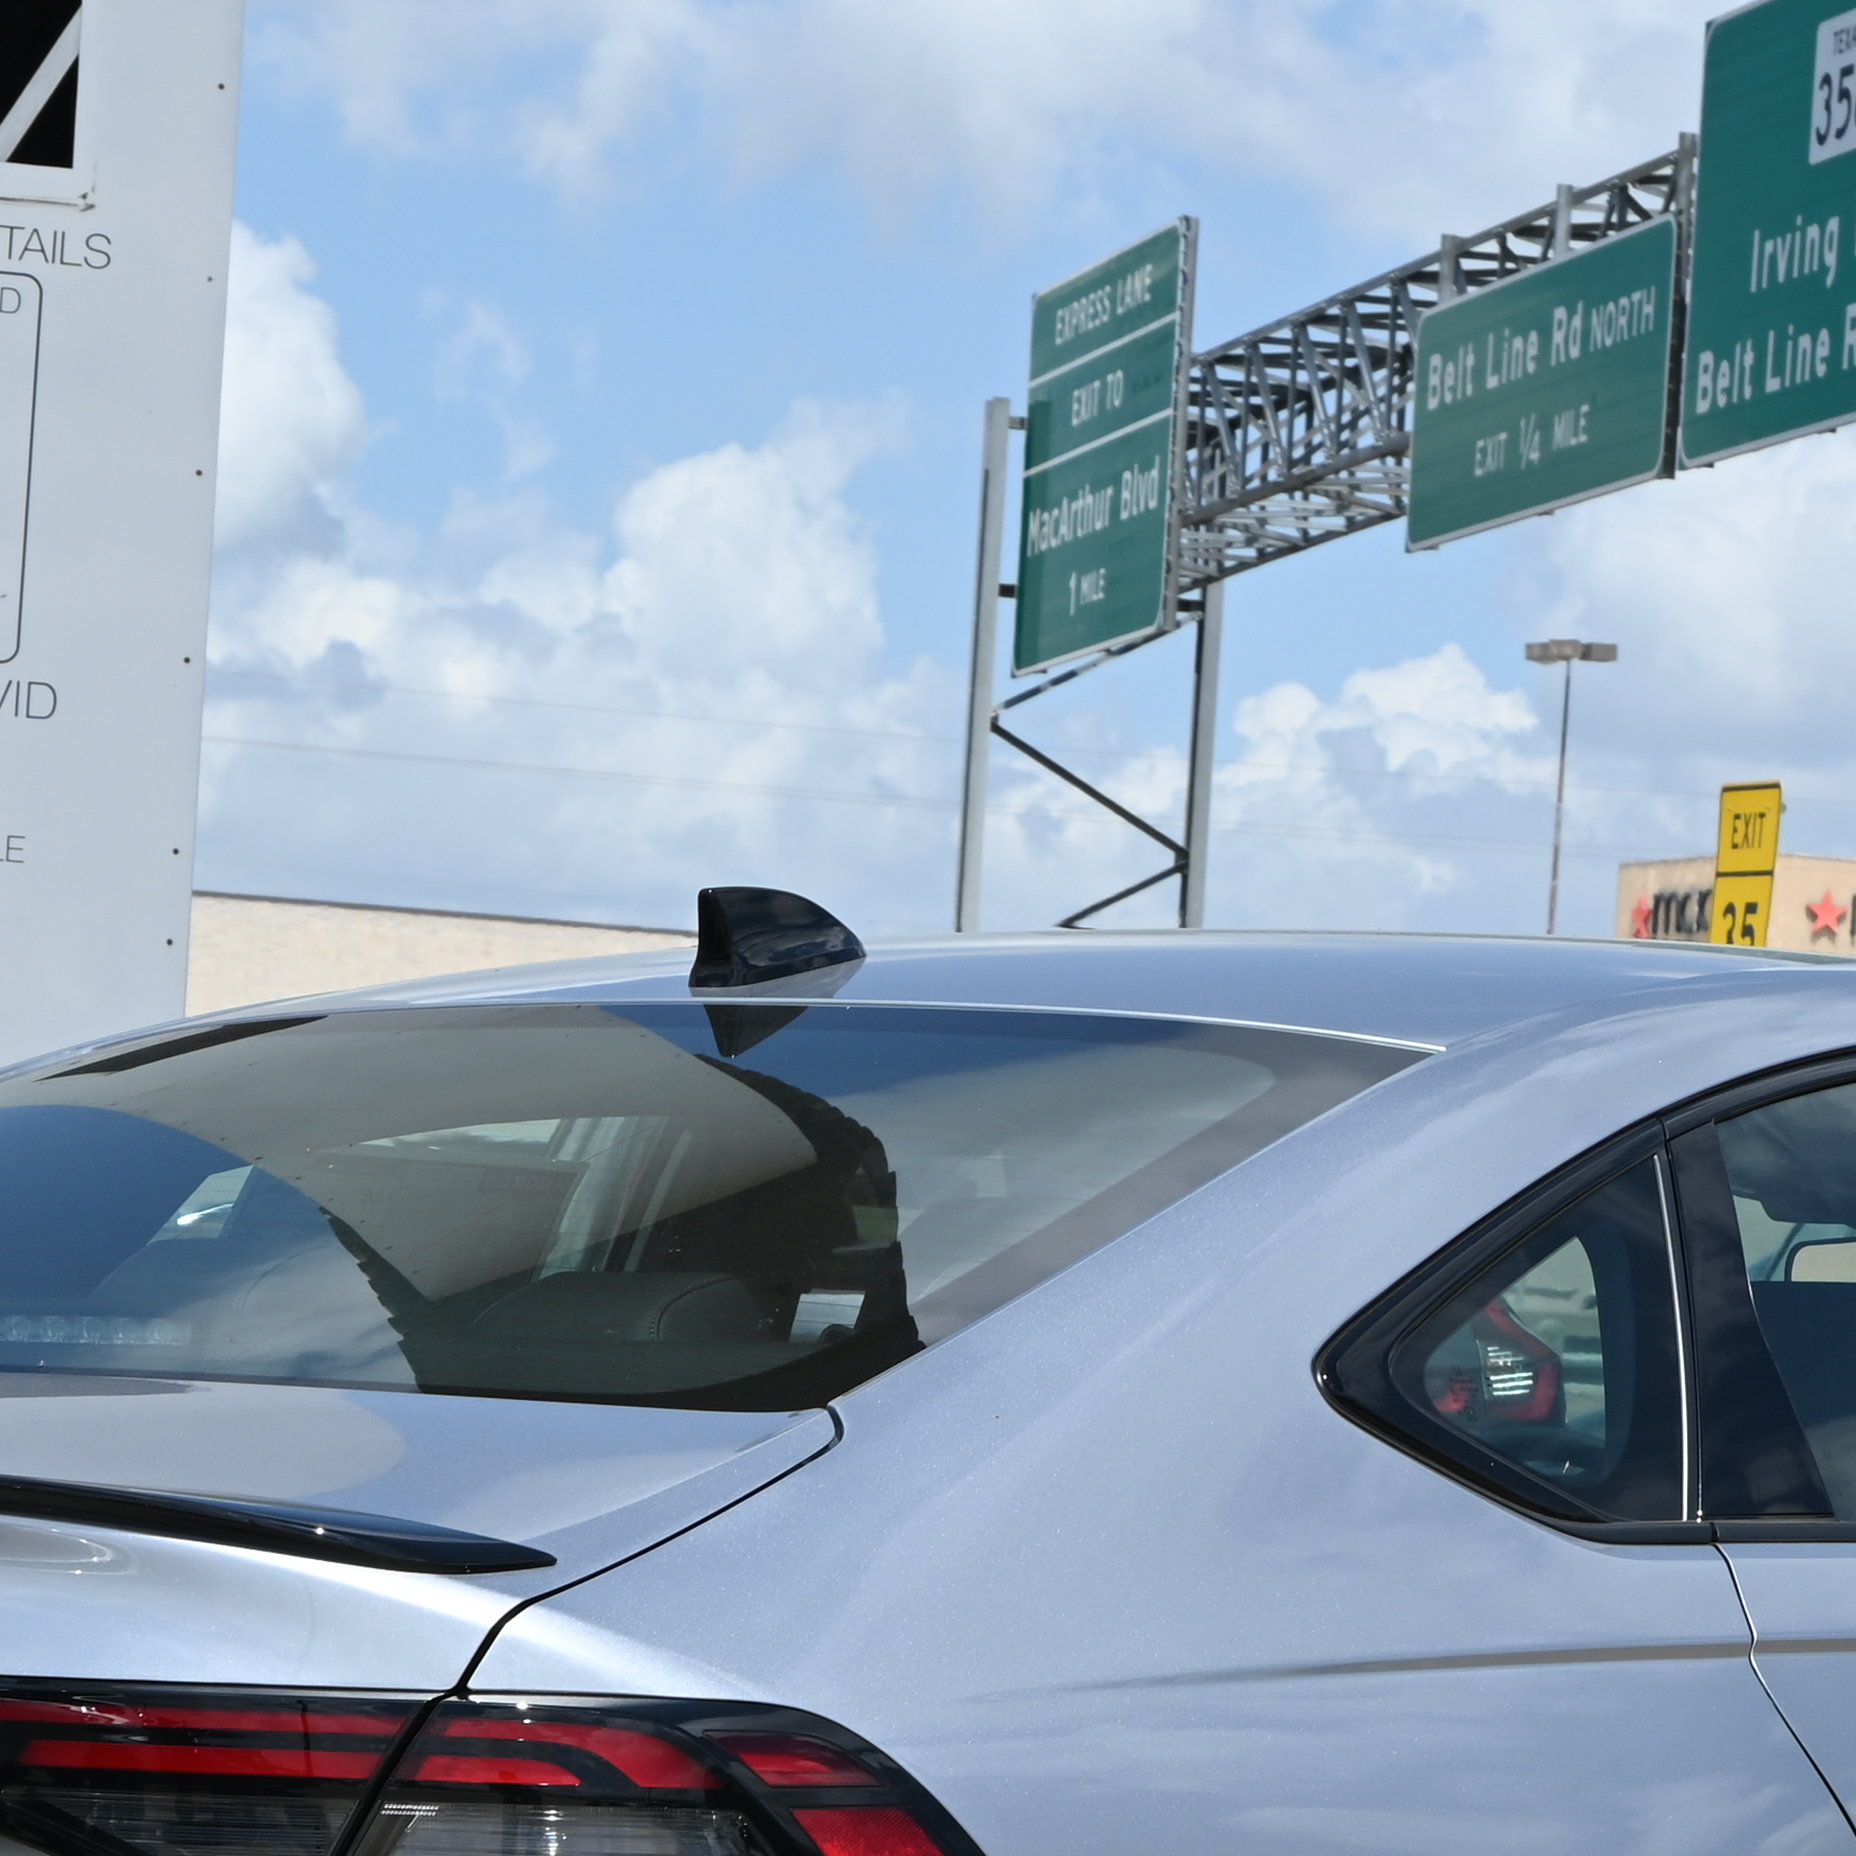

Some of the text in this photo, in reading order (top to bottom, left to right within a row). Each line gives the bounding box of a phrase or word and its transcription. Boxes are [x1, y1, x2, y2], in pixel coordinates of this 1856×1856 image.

[1750, 214, 1840, 293] Irving
[1055, 264, 1153, 345] EXPRESS LANE
[1427, 285, 1656, 411] Belt Line Rd NORTH
[1696, 338, 1754, 414] Belt
[1764, 324, 1830, 394] Line
[1072, 369, 1124, 427] EXIT TO
[1474, 431, 1508, 477] EXIT
[1552, 404, 1590, 451] MILE
[1027, 455, 1161, 557] MacArthur Blvd
[1069, 567, 1107, 615] 1 MILE
[1731, 812, 1766, 850] EXIT
[1651, 888, 1712, 935] mac
